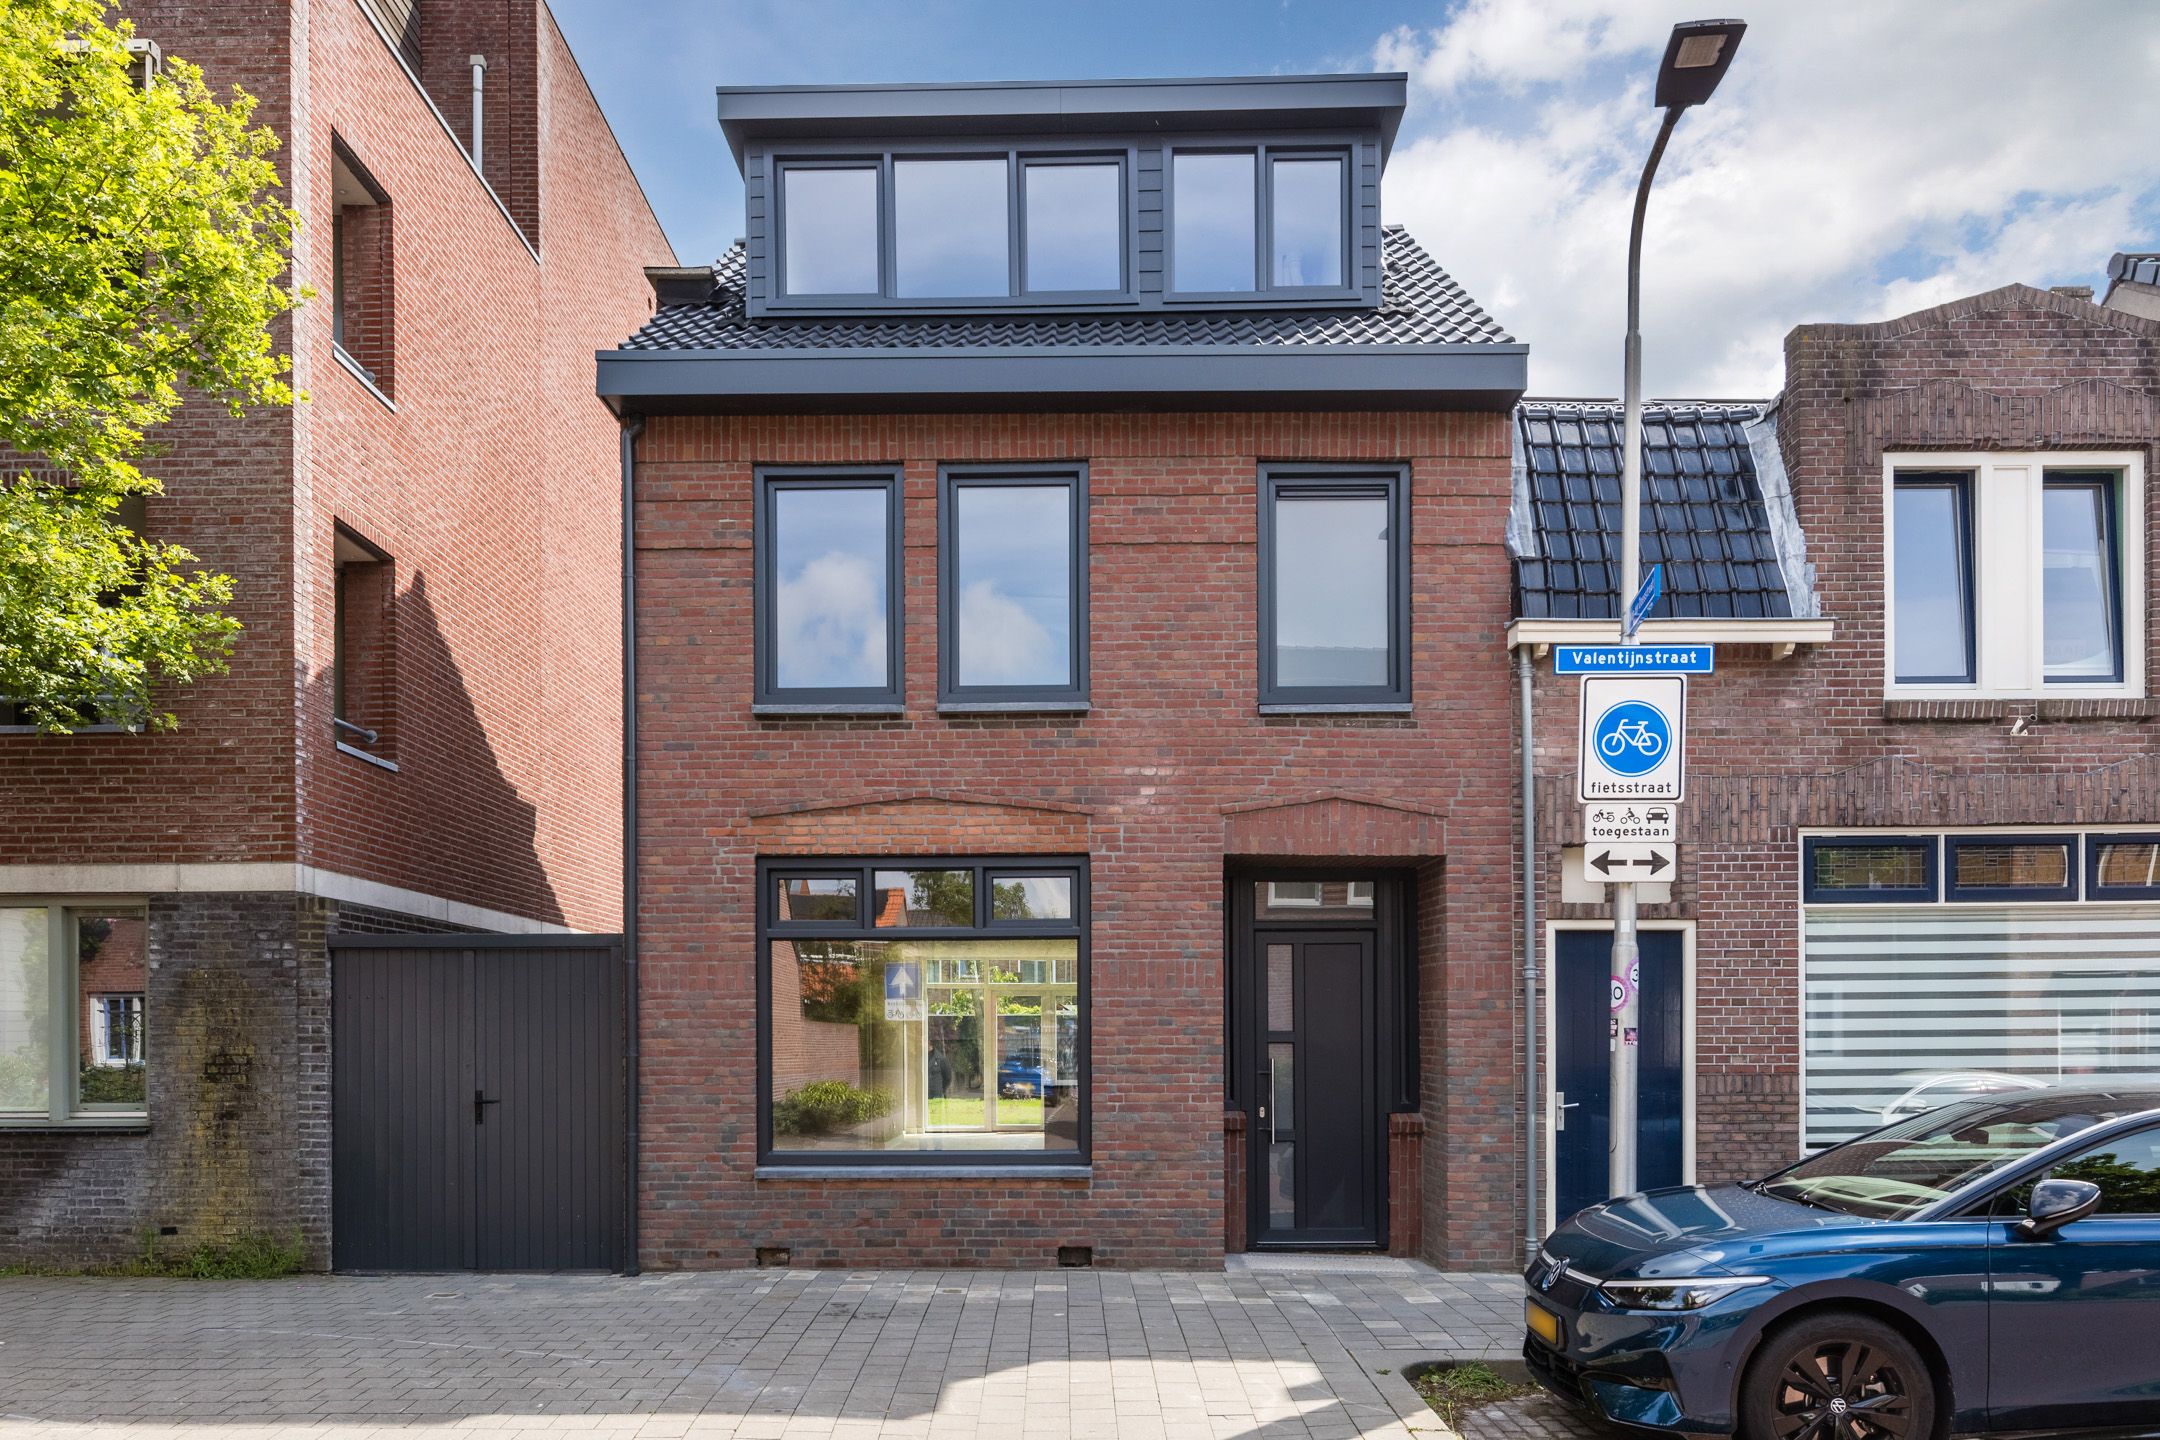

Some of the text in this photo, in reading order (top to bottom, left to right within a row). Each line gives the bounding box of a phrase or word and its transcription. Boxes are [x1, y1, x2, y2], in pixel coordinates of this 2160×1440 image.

[1572, 651, 1697, 668] Valentijnstraat
[1591, 782, 1672, 793] fietsstraat
[1592, 827, 1670, 839] toegestaan
